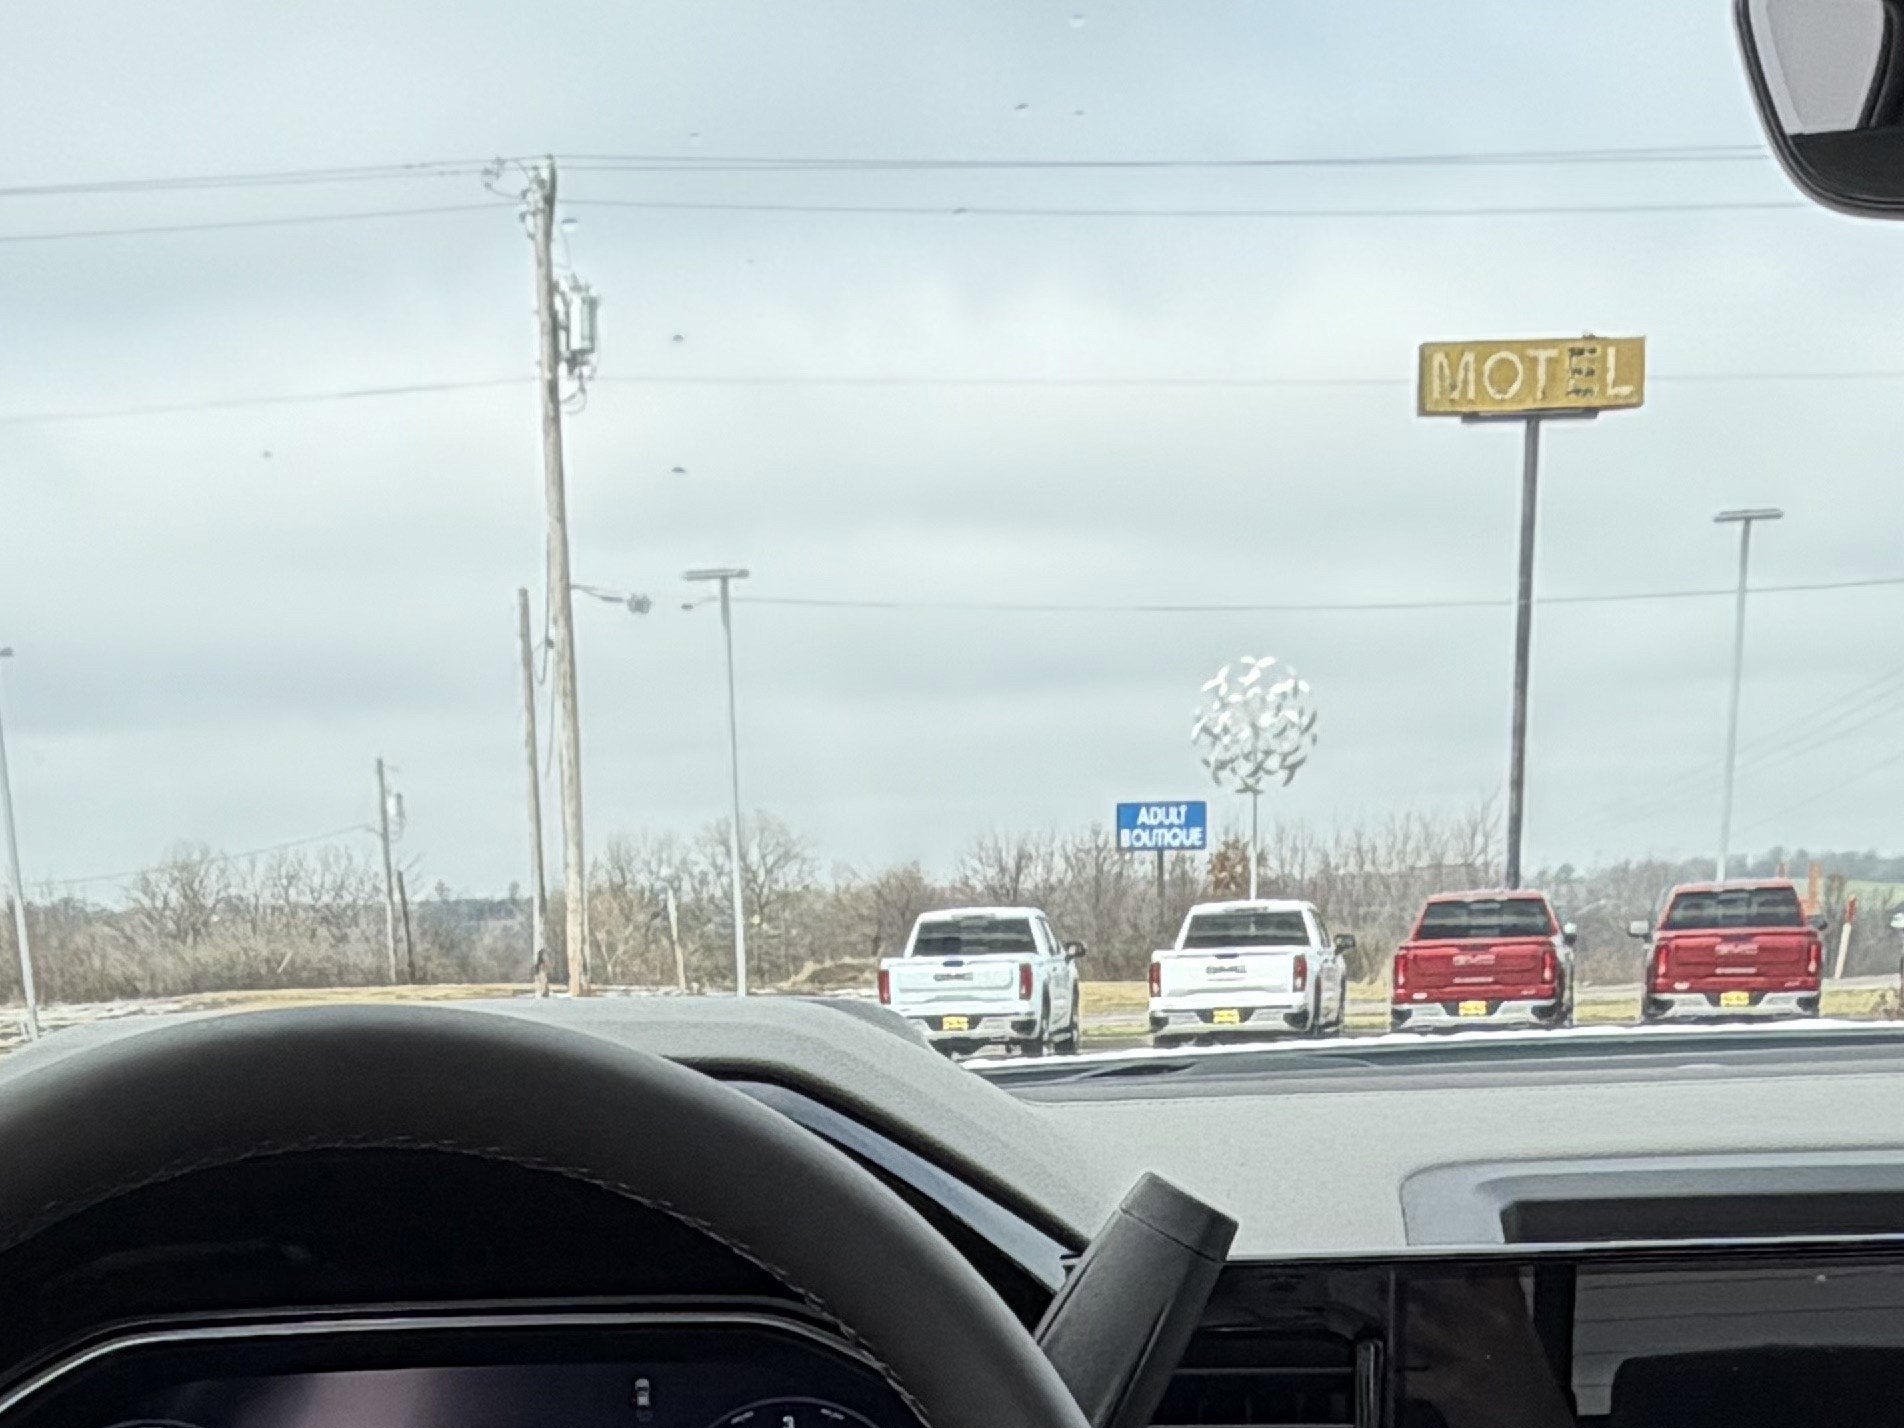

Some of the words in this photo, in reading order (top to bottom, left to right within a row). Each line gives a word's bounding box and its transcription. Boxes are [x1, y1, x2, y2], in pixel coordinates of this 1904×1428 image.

[1432, 343, 1634, 401] MOTEL
[1137, 805, 1186, 826] ADULT
[1121, 826, 1203, 848] BOUTIQUE
